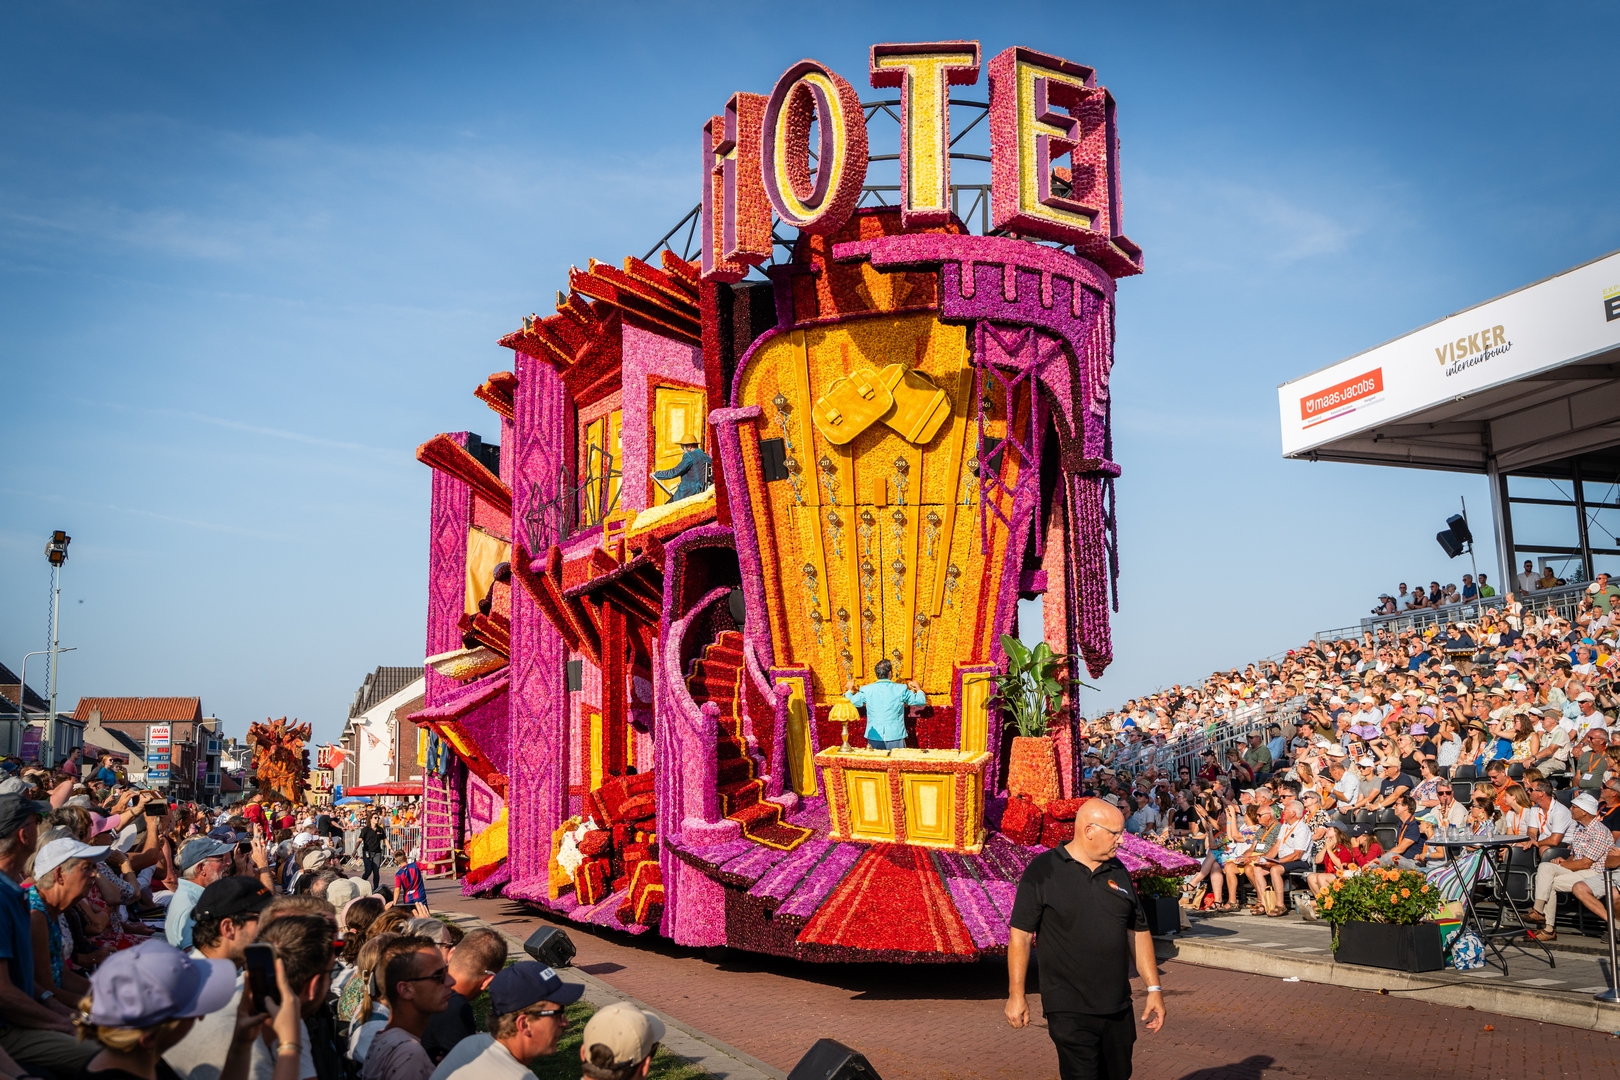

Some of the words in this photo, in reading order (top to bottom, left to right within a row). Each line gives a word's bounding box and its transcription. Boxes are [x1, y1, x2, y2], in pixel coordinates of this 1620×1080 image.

[1602, 284, 1620, 295] EXP
[1435, 324, 1507, 366] VISKER
[1445, 341, 1513, 377] interieurbouw
